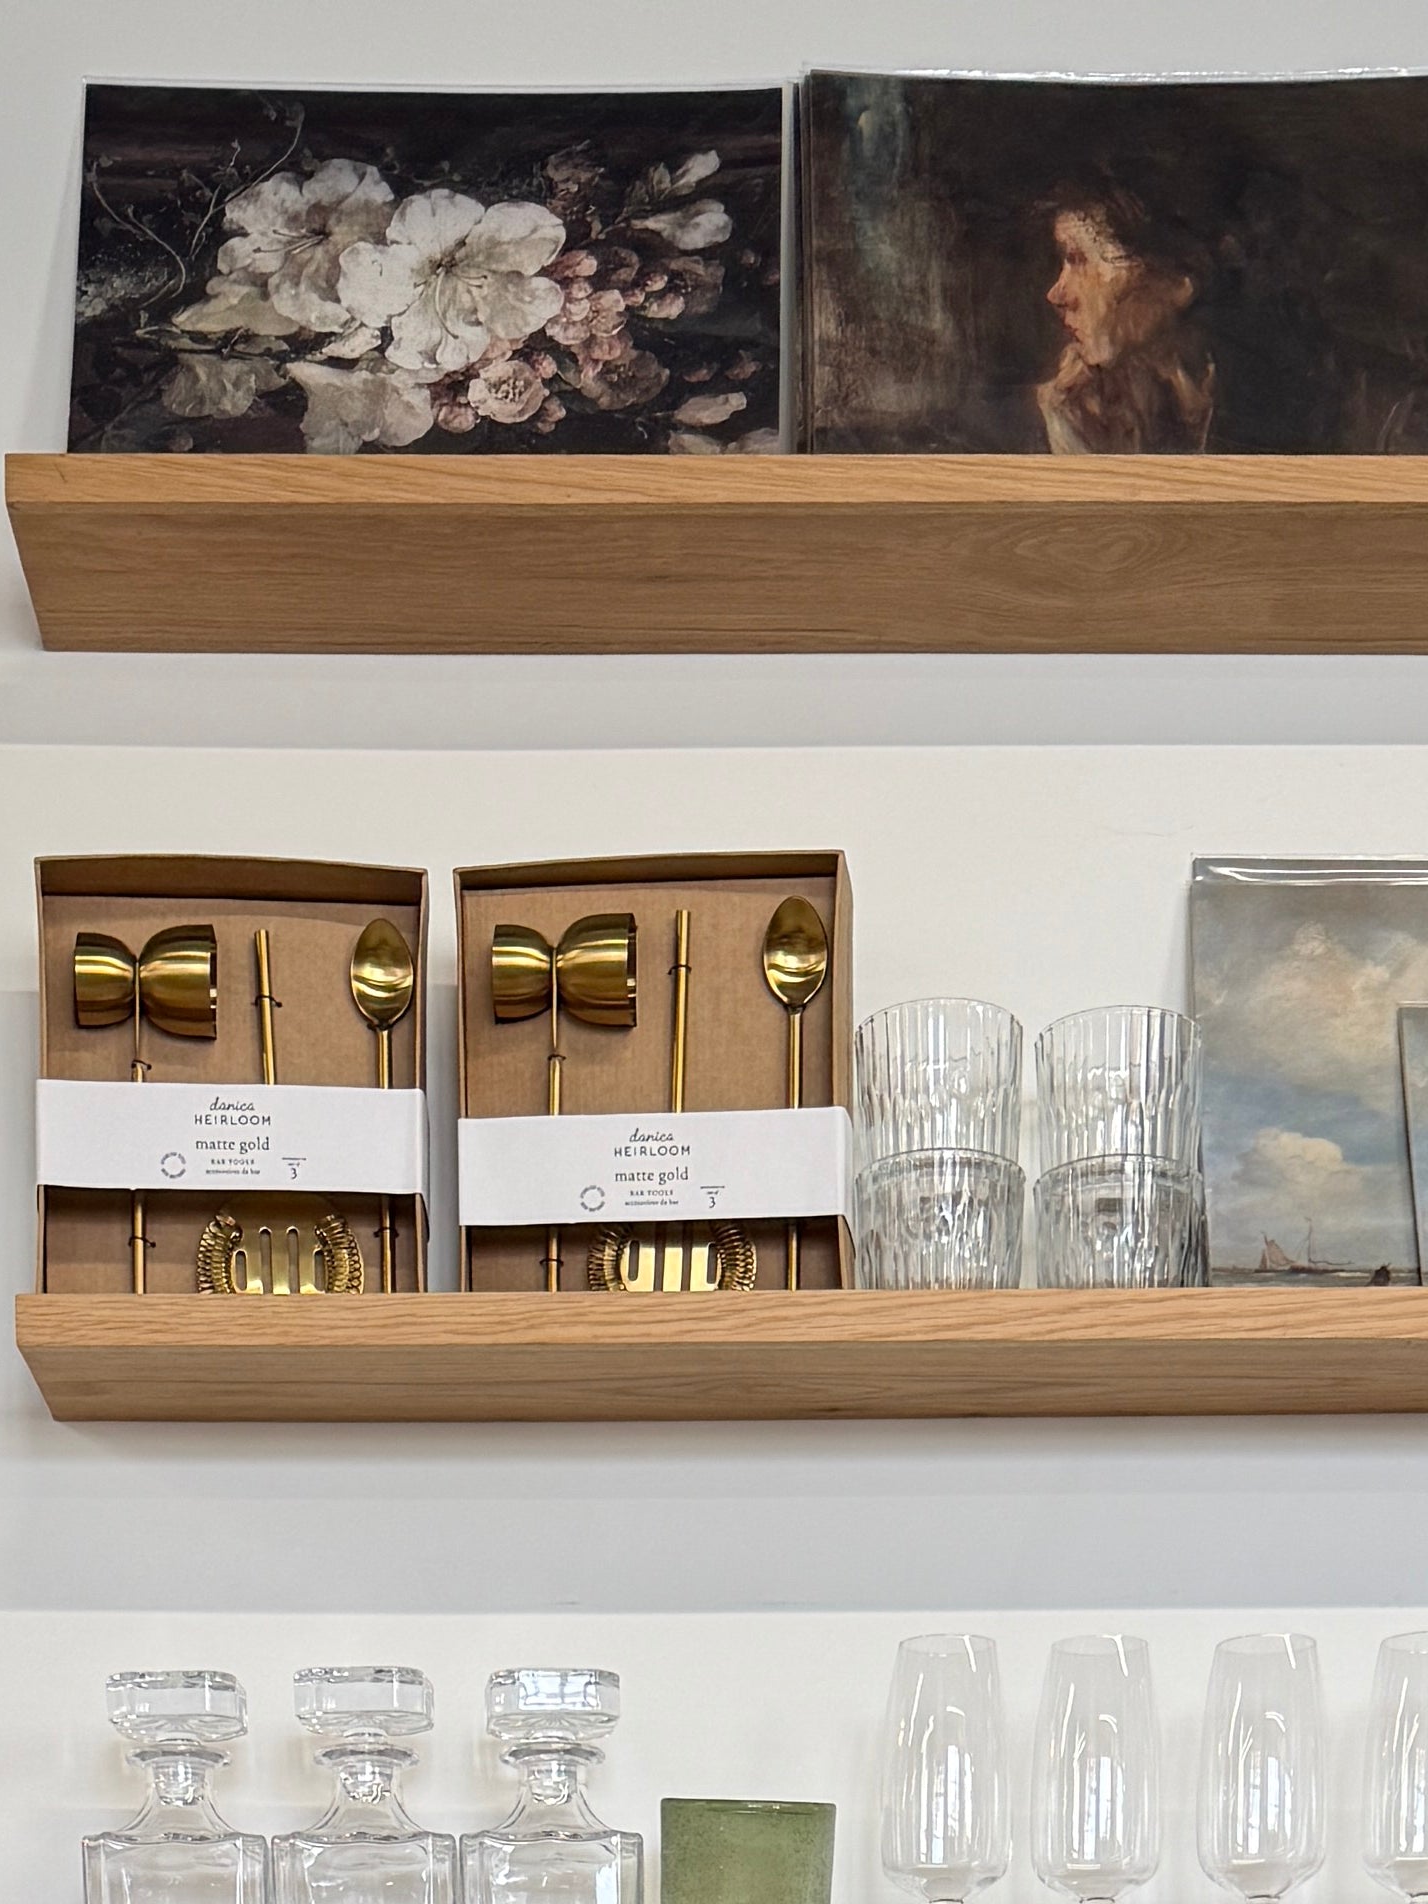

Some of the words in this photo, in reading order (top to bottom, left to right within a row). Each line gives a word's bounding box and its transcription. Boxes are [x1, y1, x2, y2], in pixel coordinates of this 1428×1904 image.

[209, 1096, 255, 1111] danica
[194, 1114, 271, 1126] HEIRLOOM
[629, 1127, 675, 1142] danica
[195, 1139, 236, 1151] matte
[239, 1136, 270, 1154] gold
[614, 1145, 691, 1157] HEIRLOOM
[614, 1170, 655, 1182] matte
[658, 1166, 689, 1185] gold
